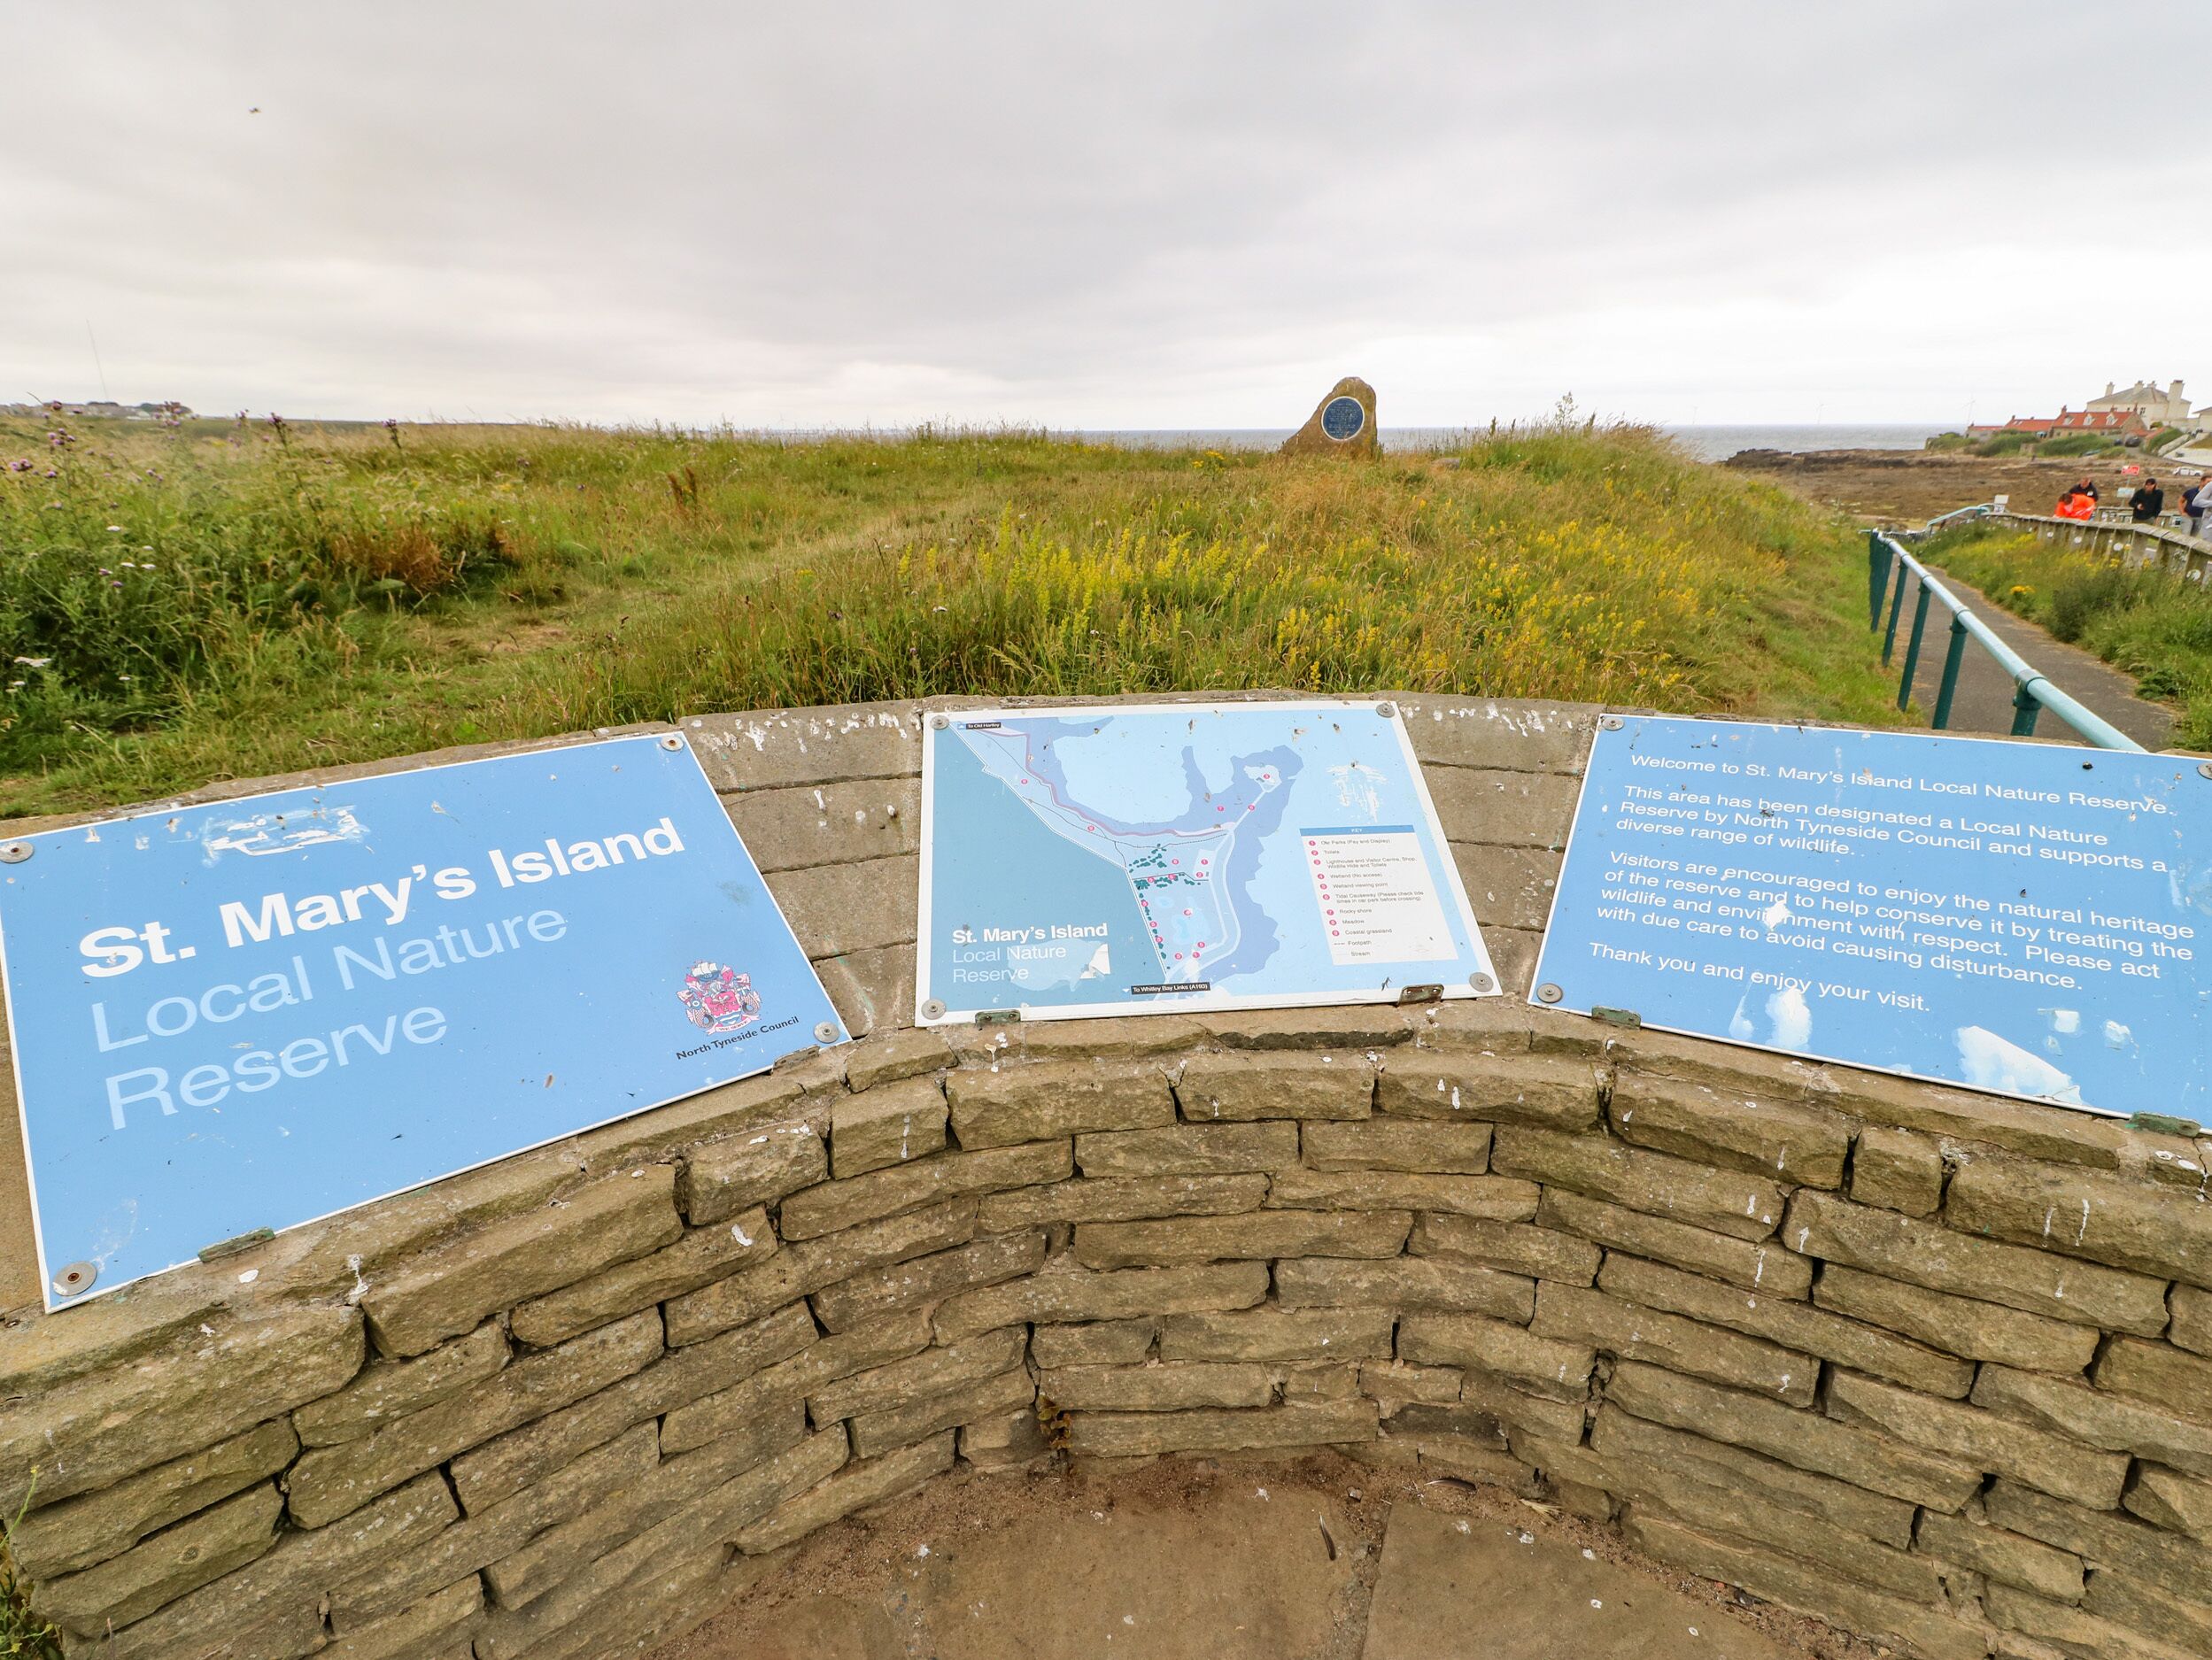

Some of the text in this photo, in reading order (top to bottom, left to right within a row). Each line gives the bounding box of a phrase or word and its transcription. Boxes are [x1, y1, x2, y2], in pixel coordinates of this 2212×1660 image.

[1625, 786, 2108, 845] This area has been designated a Local Nature
[1632, 755, 2177, 815] Welcome to St. Mary’s Island Local Nature Reserve.
[1616, 818, 1854, 854] diverse range of wildlife.
[1620, 801, 2168, 872] Reserve by North Tyneside Council and supports a
[80, 818, 685, 978] St. Mary’s Island
[1605, 870, 2193, 960] of the reserve and to help conserve it by treating the
[1611, 851, 2194, 939] Visitors are encouraged to enjoy the natural heritage
[952, 923, 1108, 944] St. Mary’s Island
[953, 945, 1067, 963] Local Nature
[1597, 907, 2082, 990] with due care to avoid causing disturbance.
[1602, 889, 1667, 907] wildlife
[1673, 899, 1712, 913] and
[1860, 924, 1906, 941] with
[1914, 932, 2007, 956] respect.
[2026, 945, 2111, 970] Please
[2121, 962, 2161, 978] act
[91, 908, 568, 1054] Local Nature
[953, 969, 1029, 983] Reserve
[1589, 943, 1930, 1011] Thank you and enjoy your visit.
[105, 1005, 447, 1131] Reserve
[676, 1045, 711, 1060] North
[711, 1031, 758, 1048] Tyneside
[760, 1016, 800, 1033] Council
